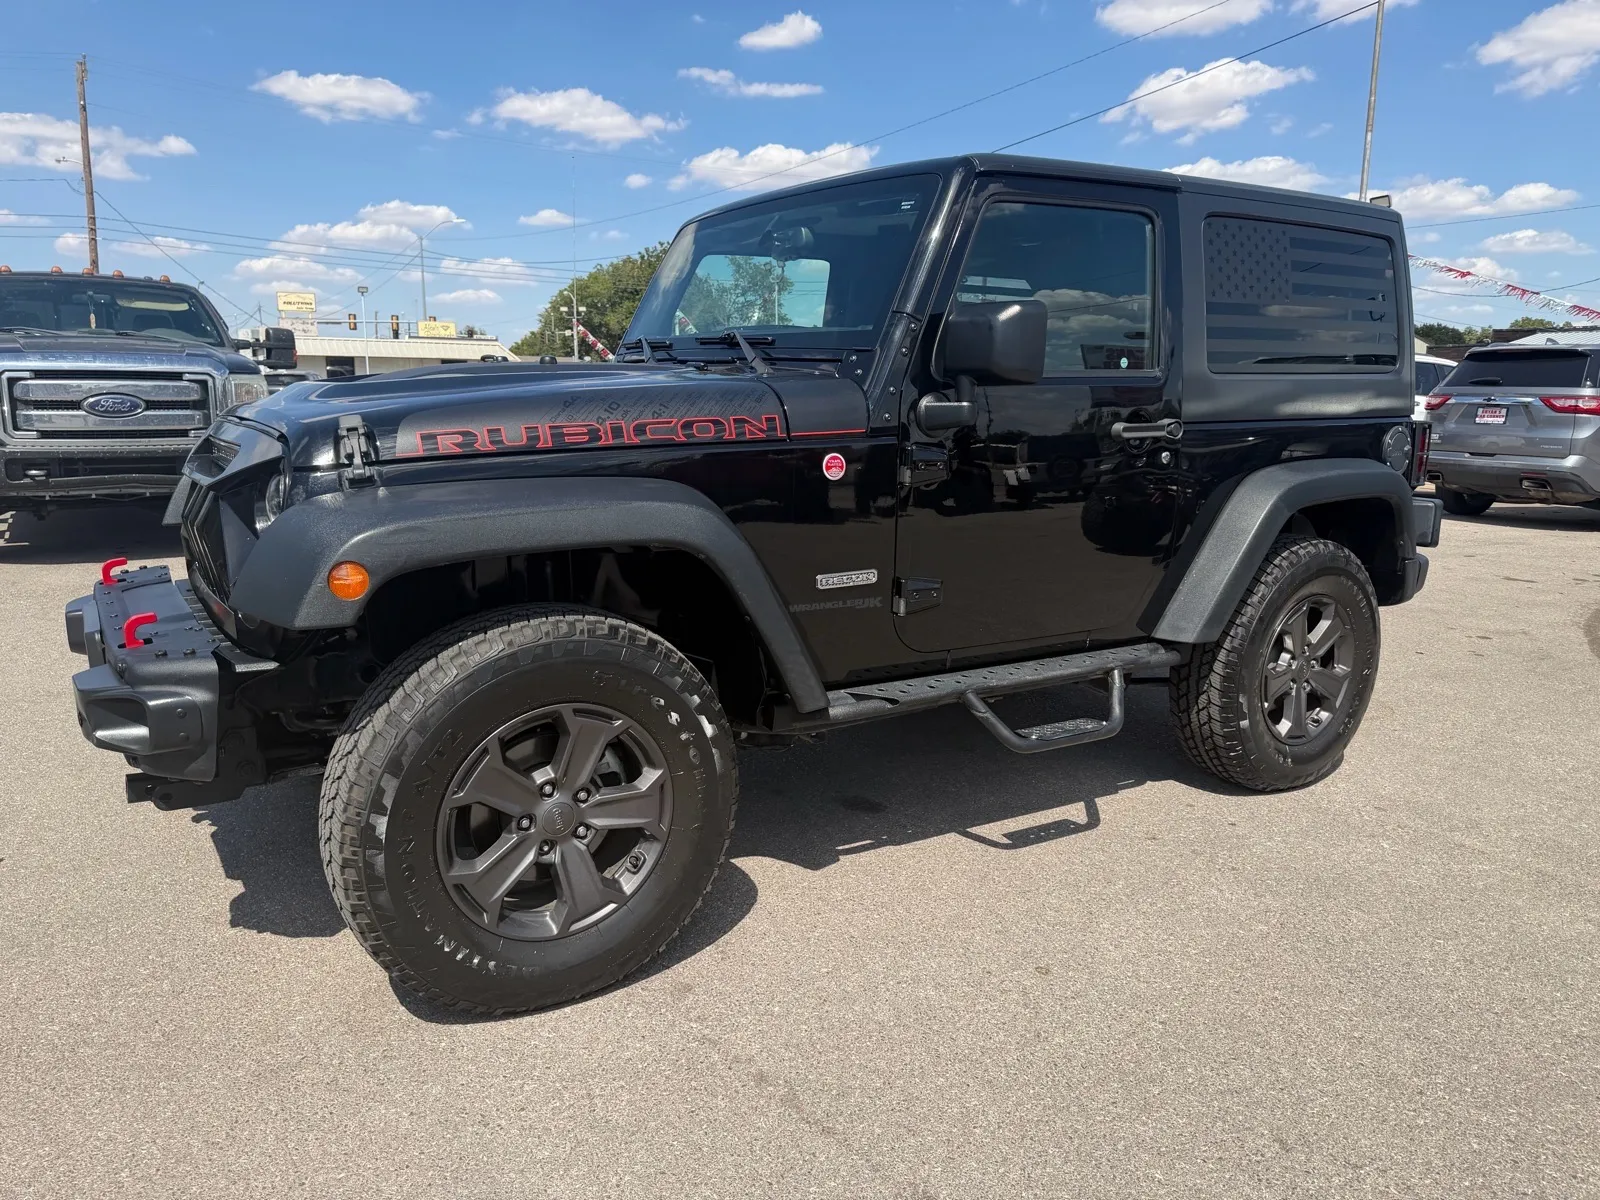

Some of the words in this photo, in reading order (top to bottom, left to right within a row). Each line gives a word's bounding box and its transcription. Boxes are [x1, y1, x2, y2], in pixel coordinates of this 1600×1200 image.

[98, 398, 130, 411] Ford
[415, 415, 787, 455] RUBICON
[821, 573, 876, 586] RECON
